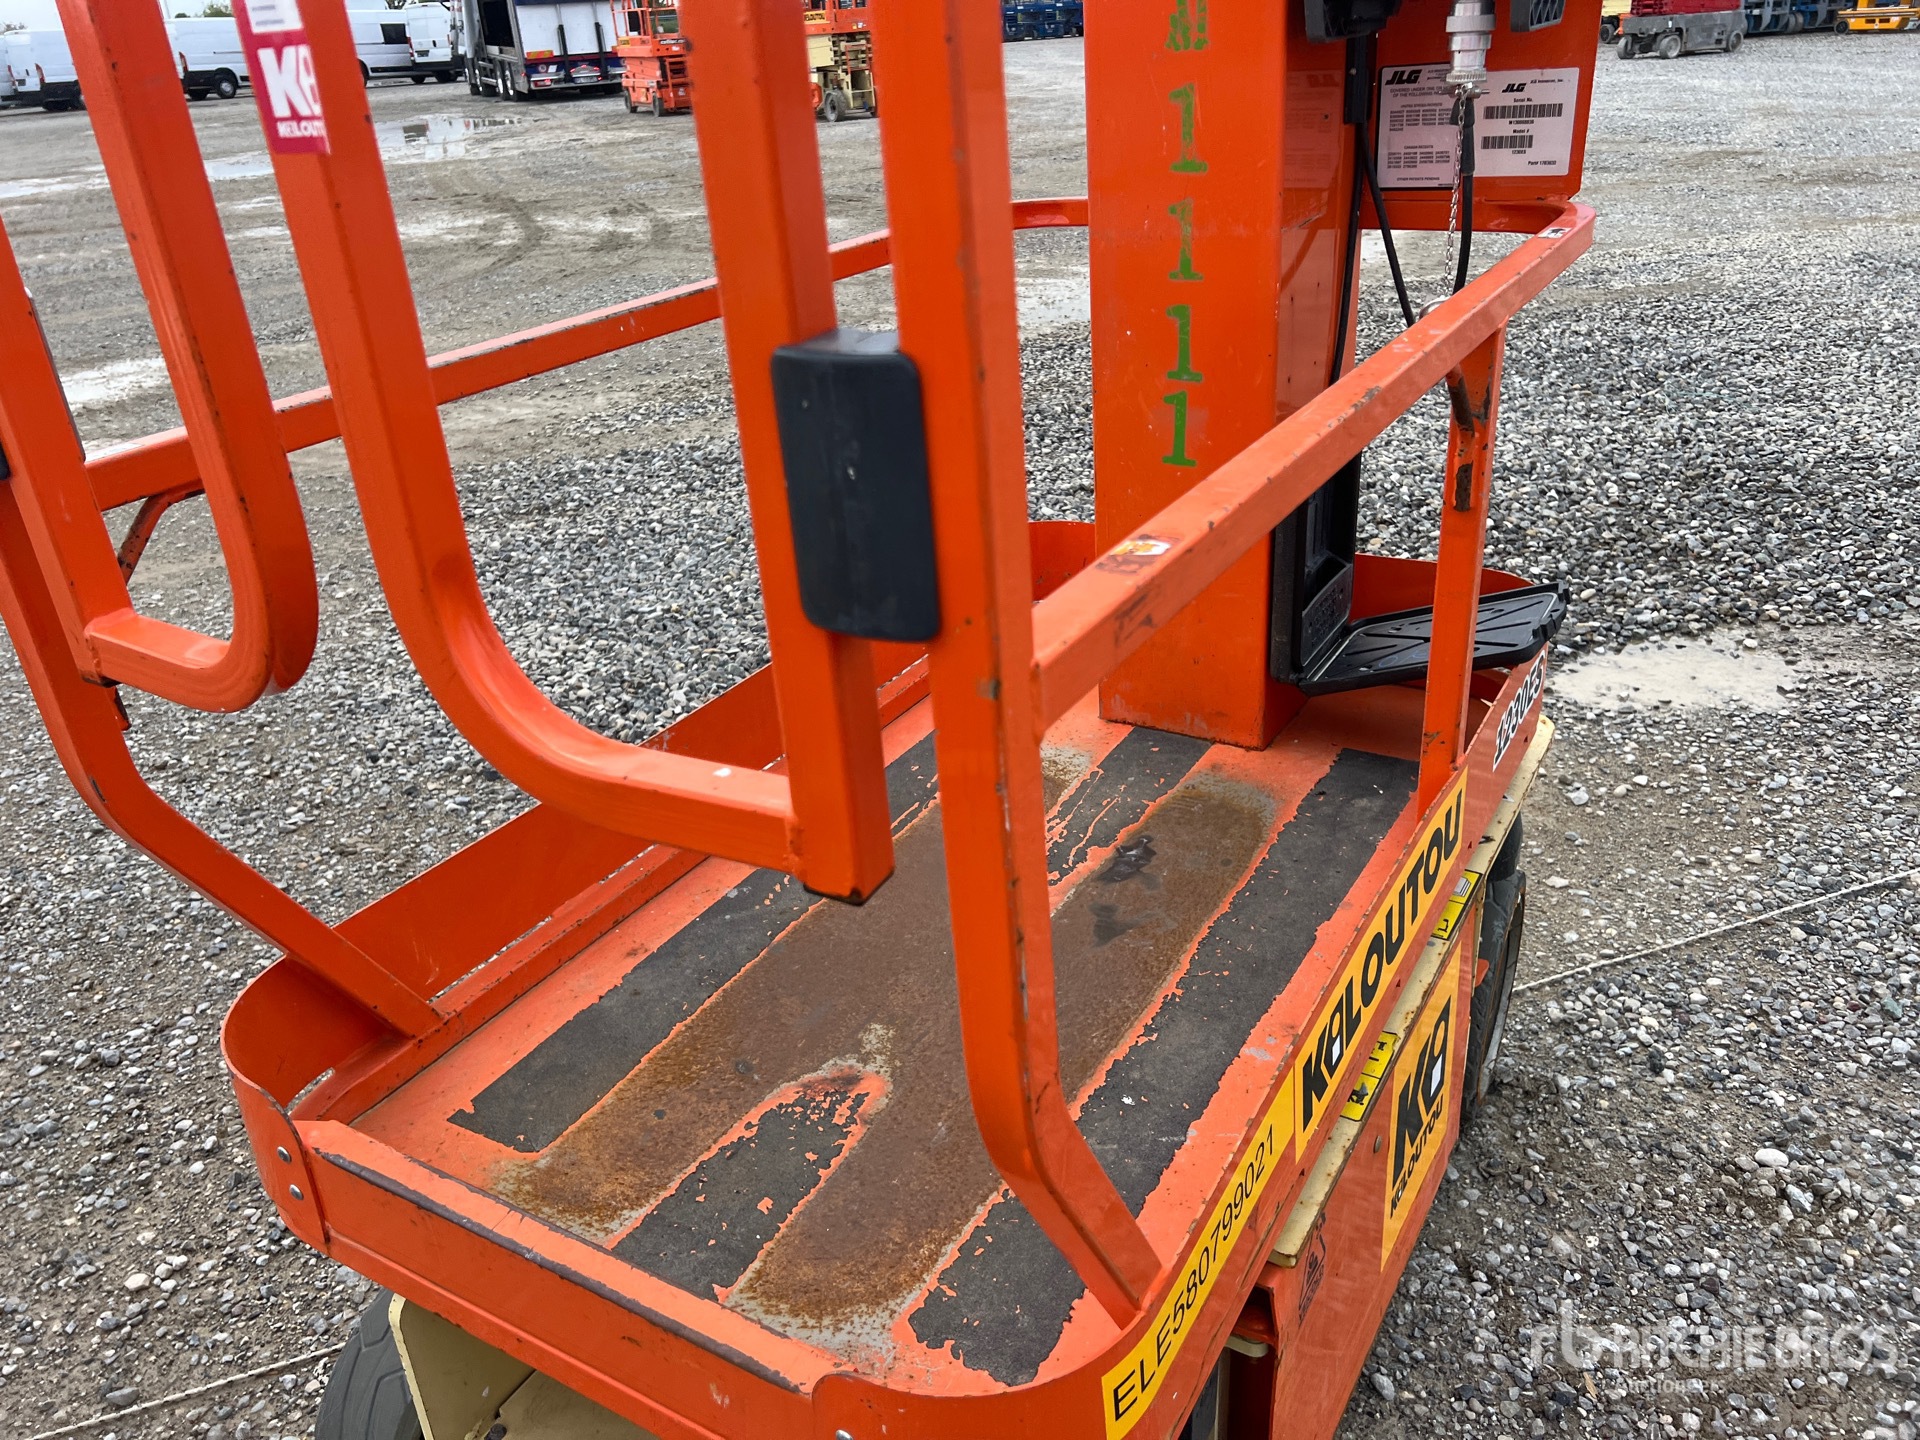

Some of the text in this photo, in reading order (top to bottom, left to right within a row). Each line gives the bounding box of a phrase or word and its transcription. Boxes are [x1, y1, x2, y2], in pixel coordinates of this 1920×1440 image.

[1385, 69, 1422, 85] JLG
[1502, 83, 1527, 93] JLG
[1493, 650, 1545, 770] 1230ES
[1113, 1123, 1274, 1422] ELE580799021
